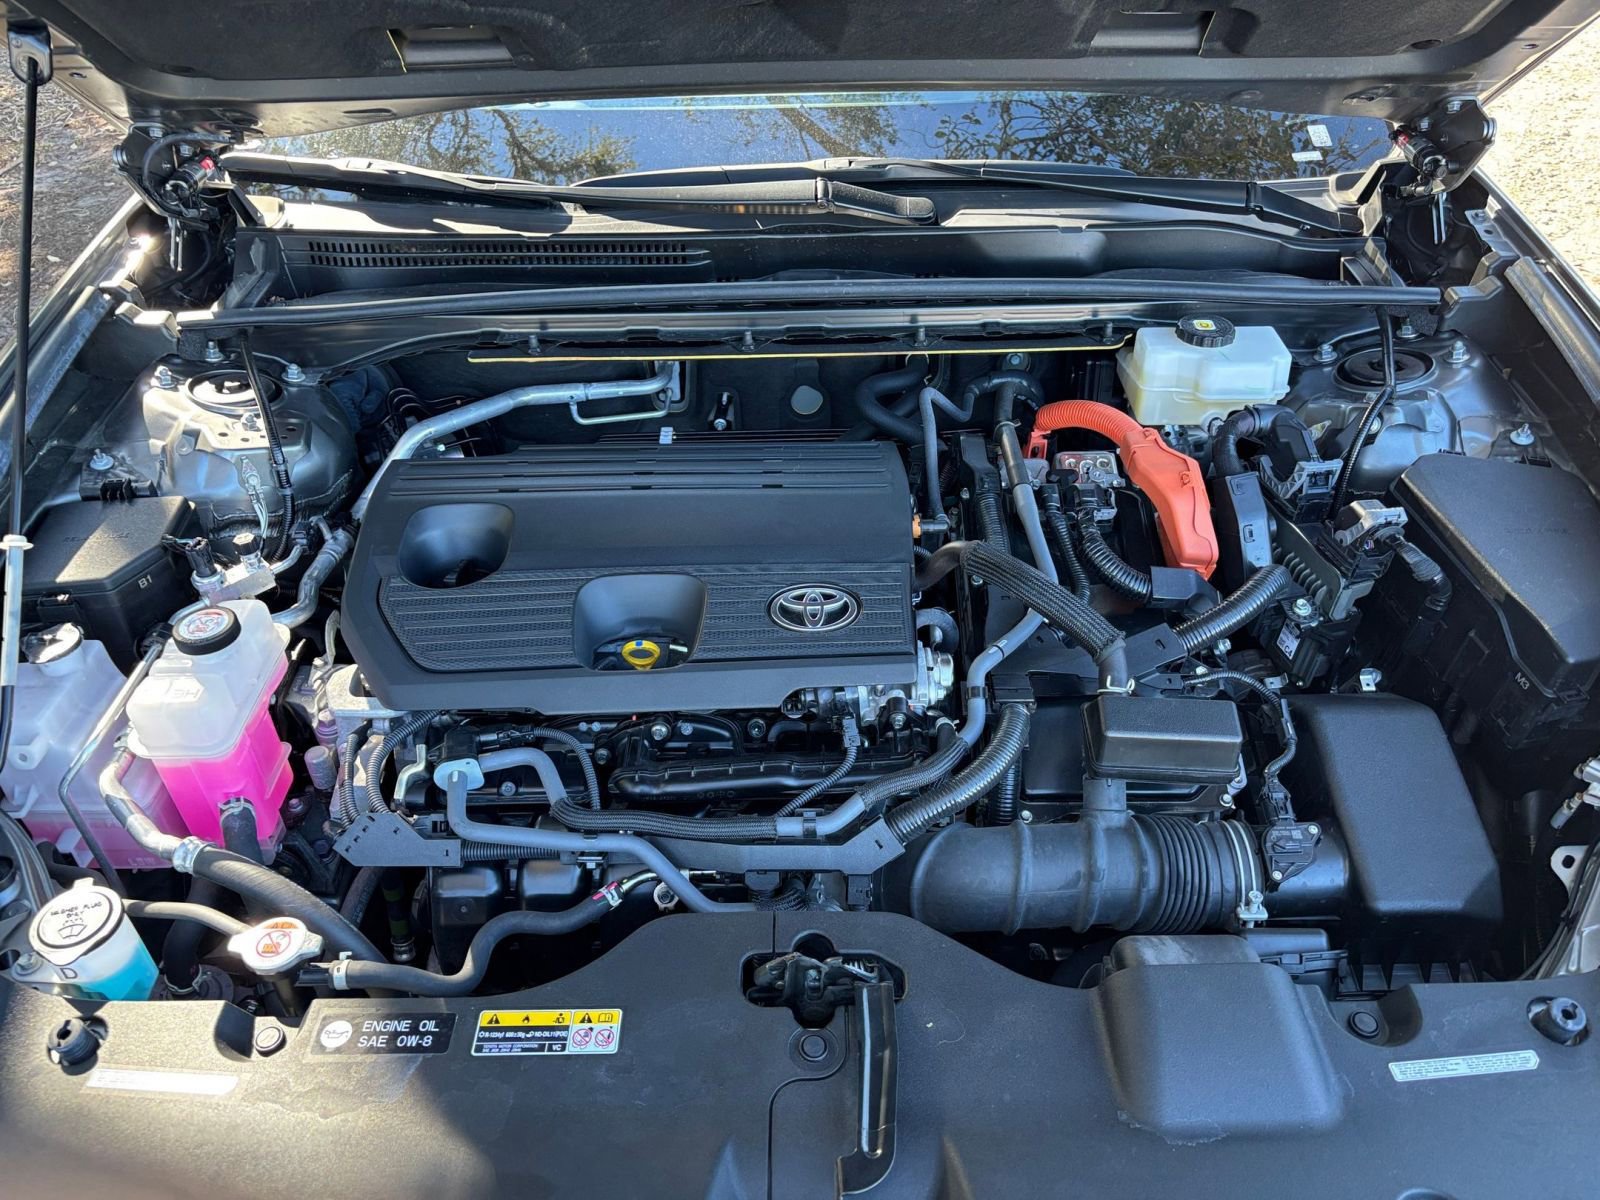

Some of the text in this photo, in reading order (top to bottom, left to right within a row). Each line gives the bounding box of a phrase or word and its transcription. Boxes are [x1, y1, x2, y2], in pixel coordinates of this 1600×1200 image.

[138, 575, 152, 588] B1
[1515, 672, 1530, 690] M3
[362, 1020, 440, 1032] ENGINE OIL
[357, 1035, 433, 1047] SAE 0W-8
